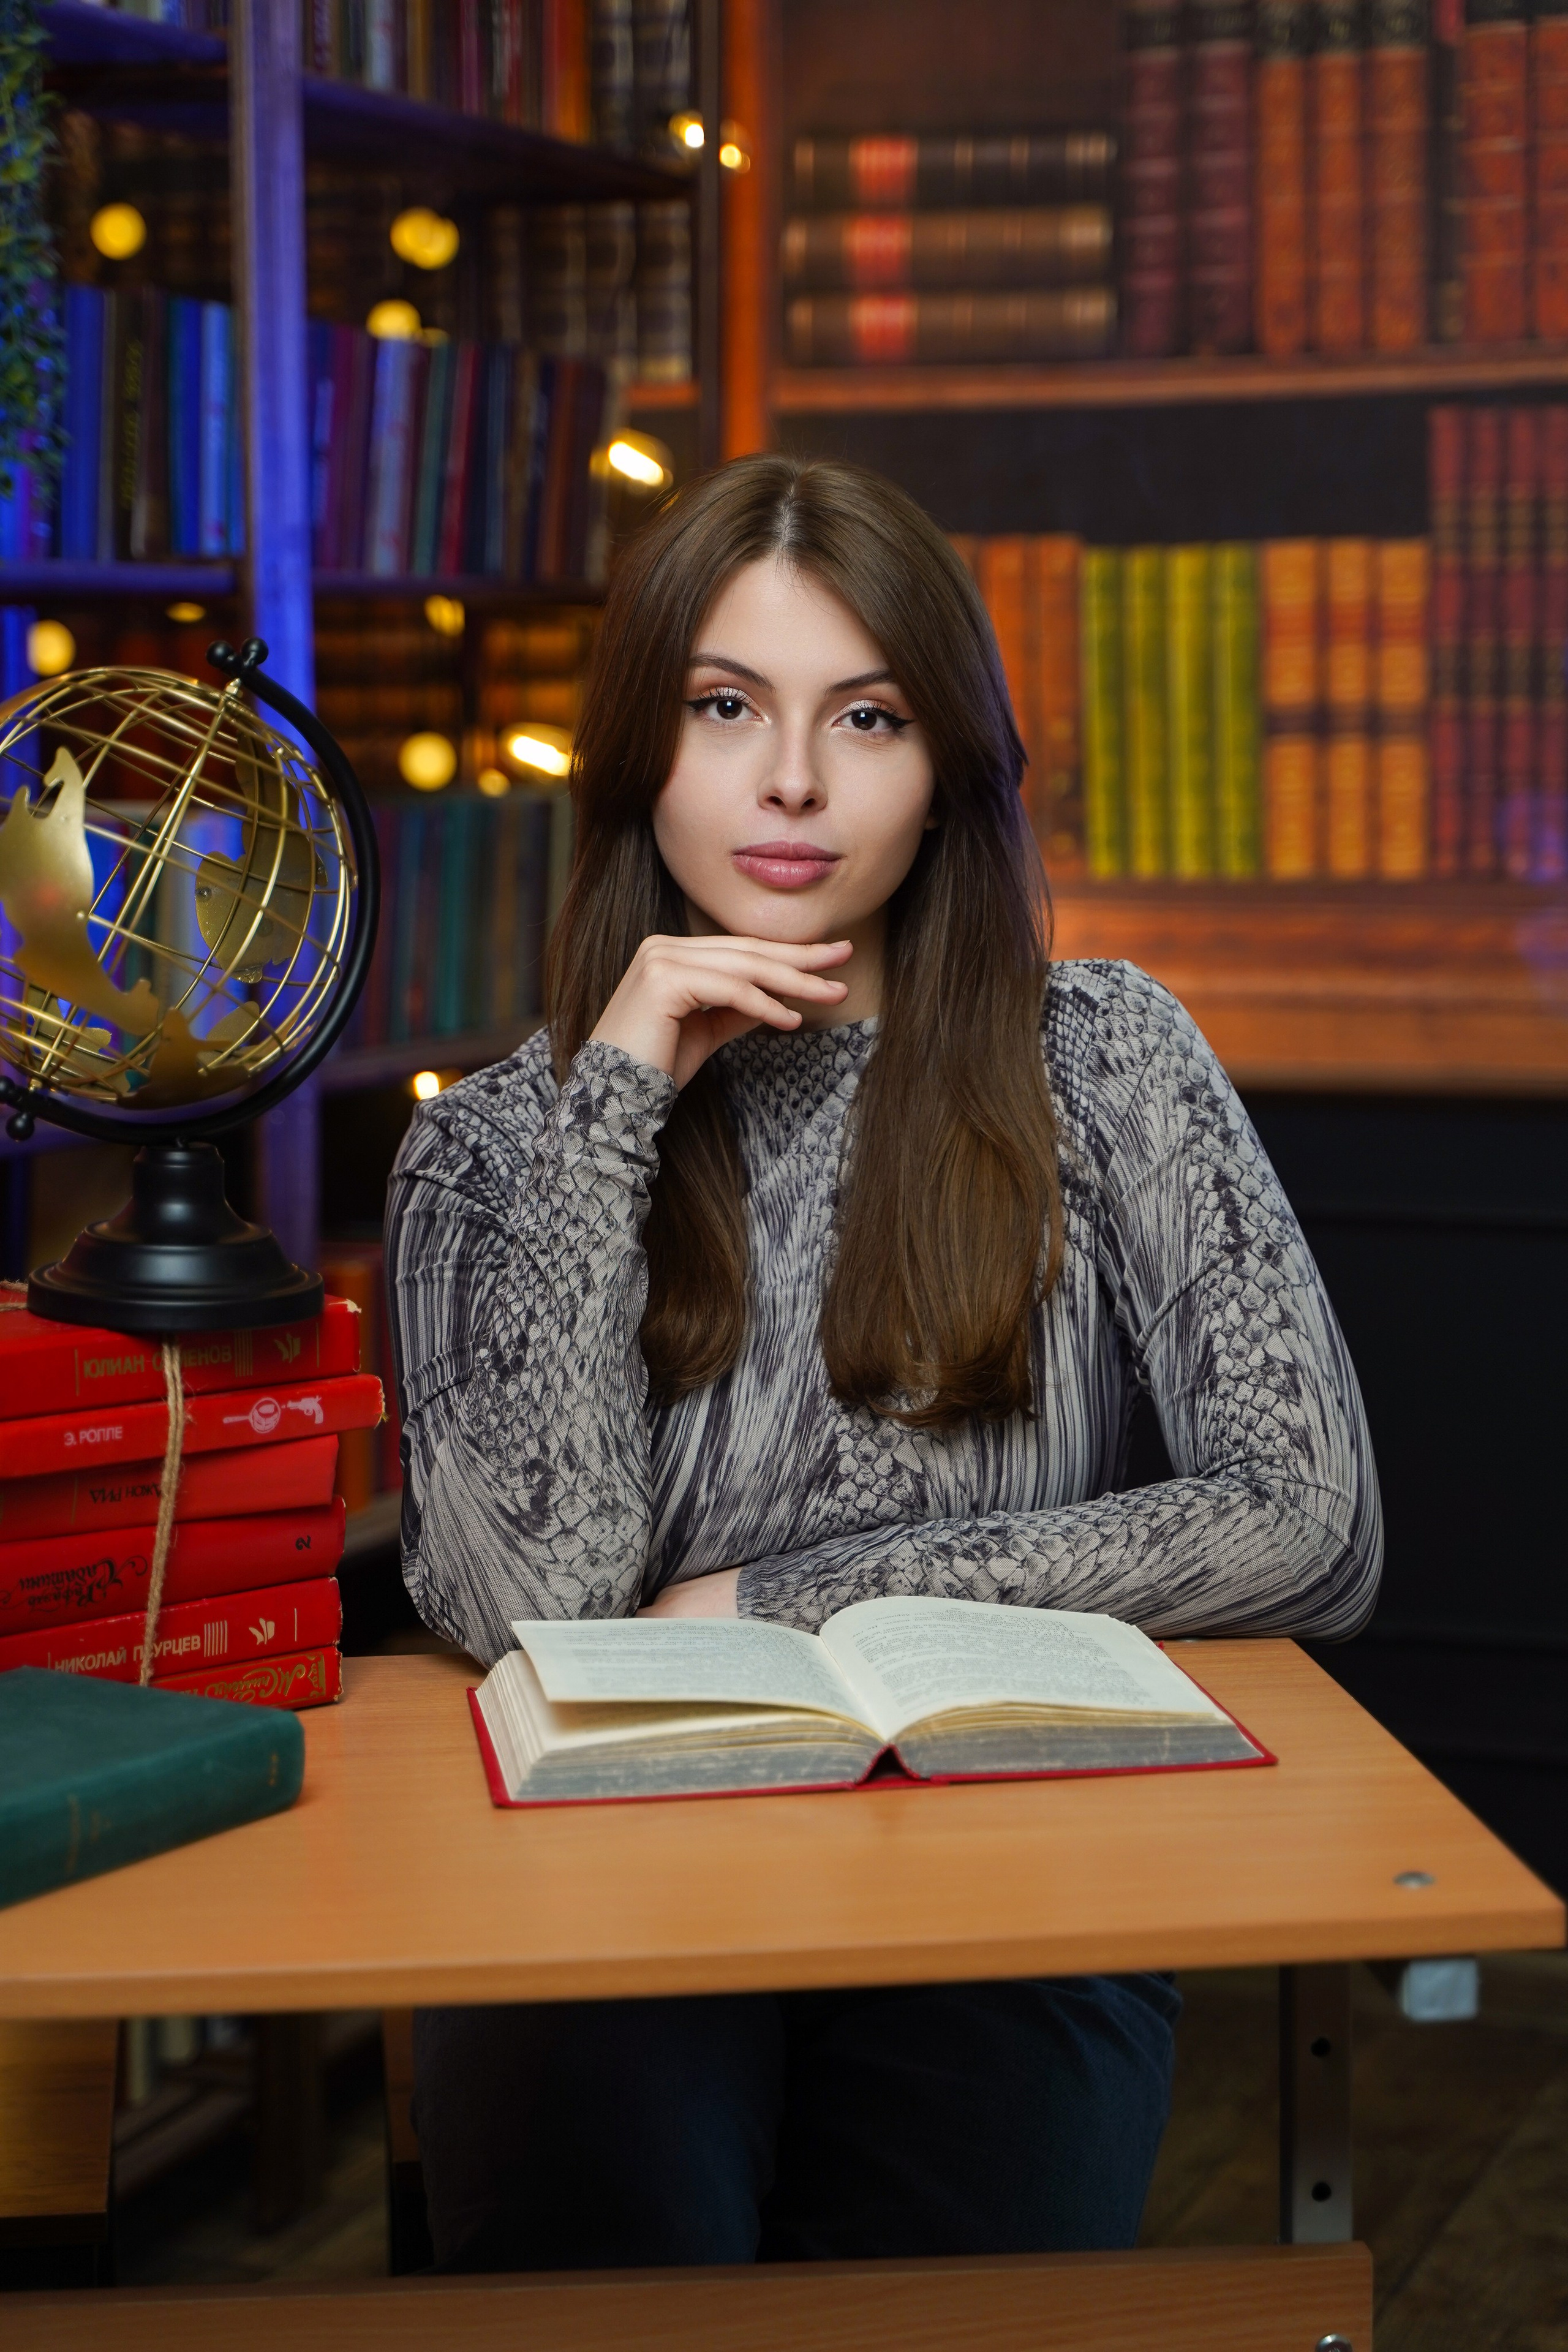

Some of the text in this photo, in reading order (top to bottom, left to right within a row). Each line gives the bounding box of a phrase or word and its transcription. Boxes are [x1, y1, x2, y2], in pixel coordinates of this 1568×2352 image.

[83, 1345, 233, 1379] ЮЛИАН СМЕНОВ
[295, 1534, 312, 1550] 2
[55, 1635, 201, 1673] НИКОЛАЙ ПУРЦЕВ
